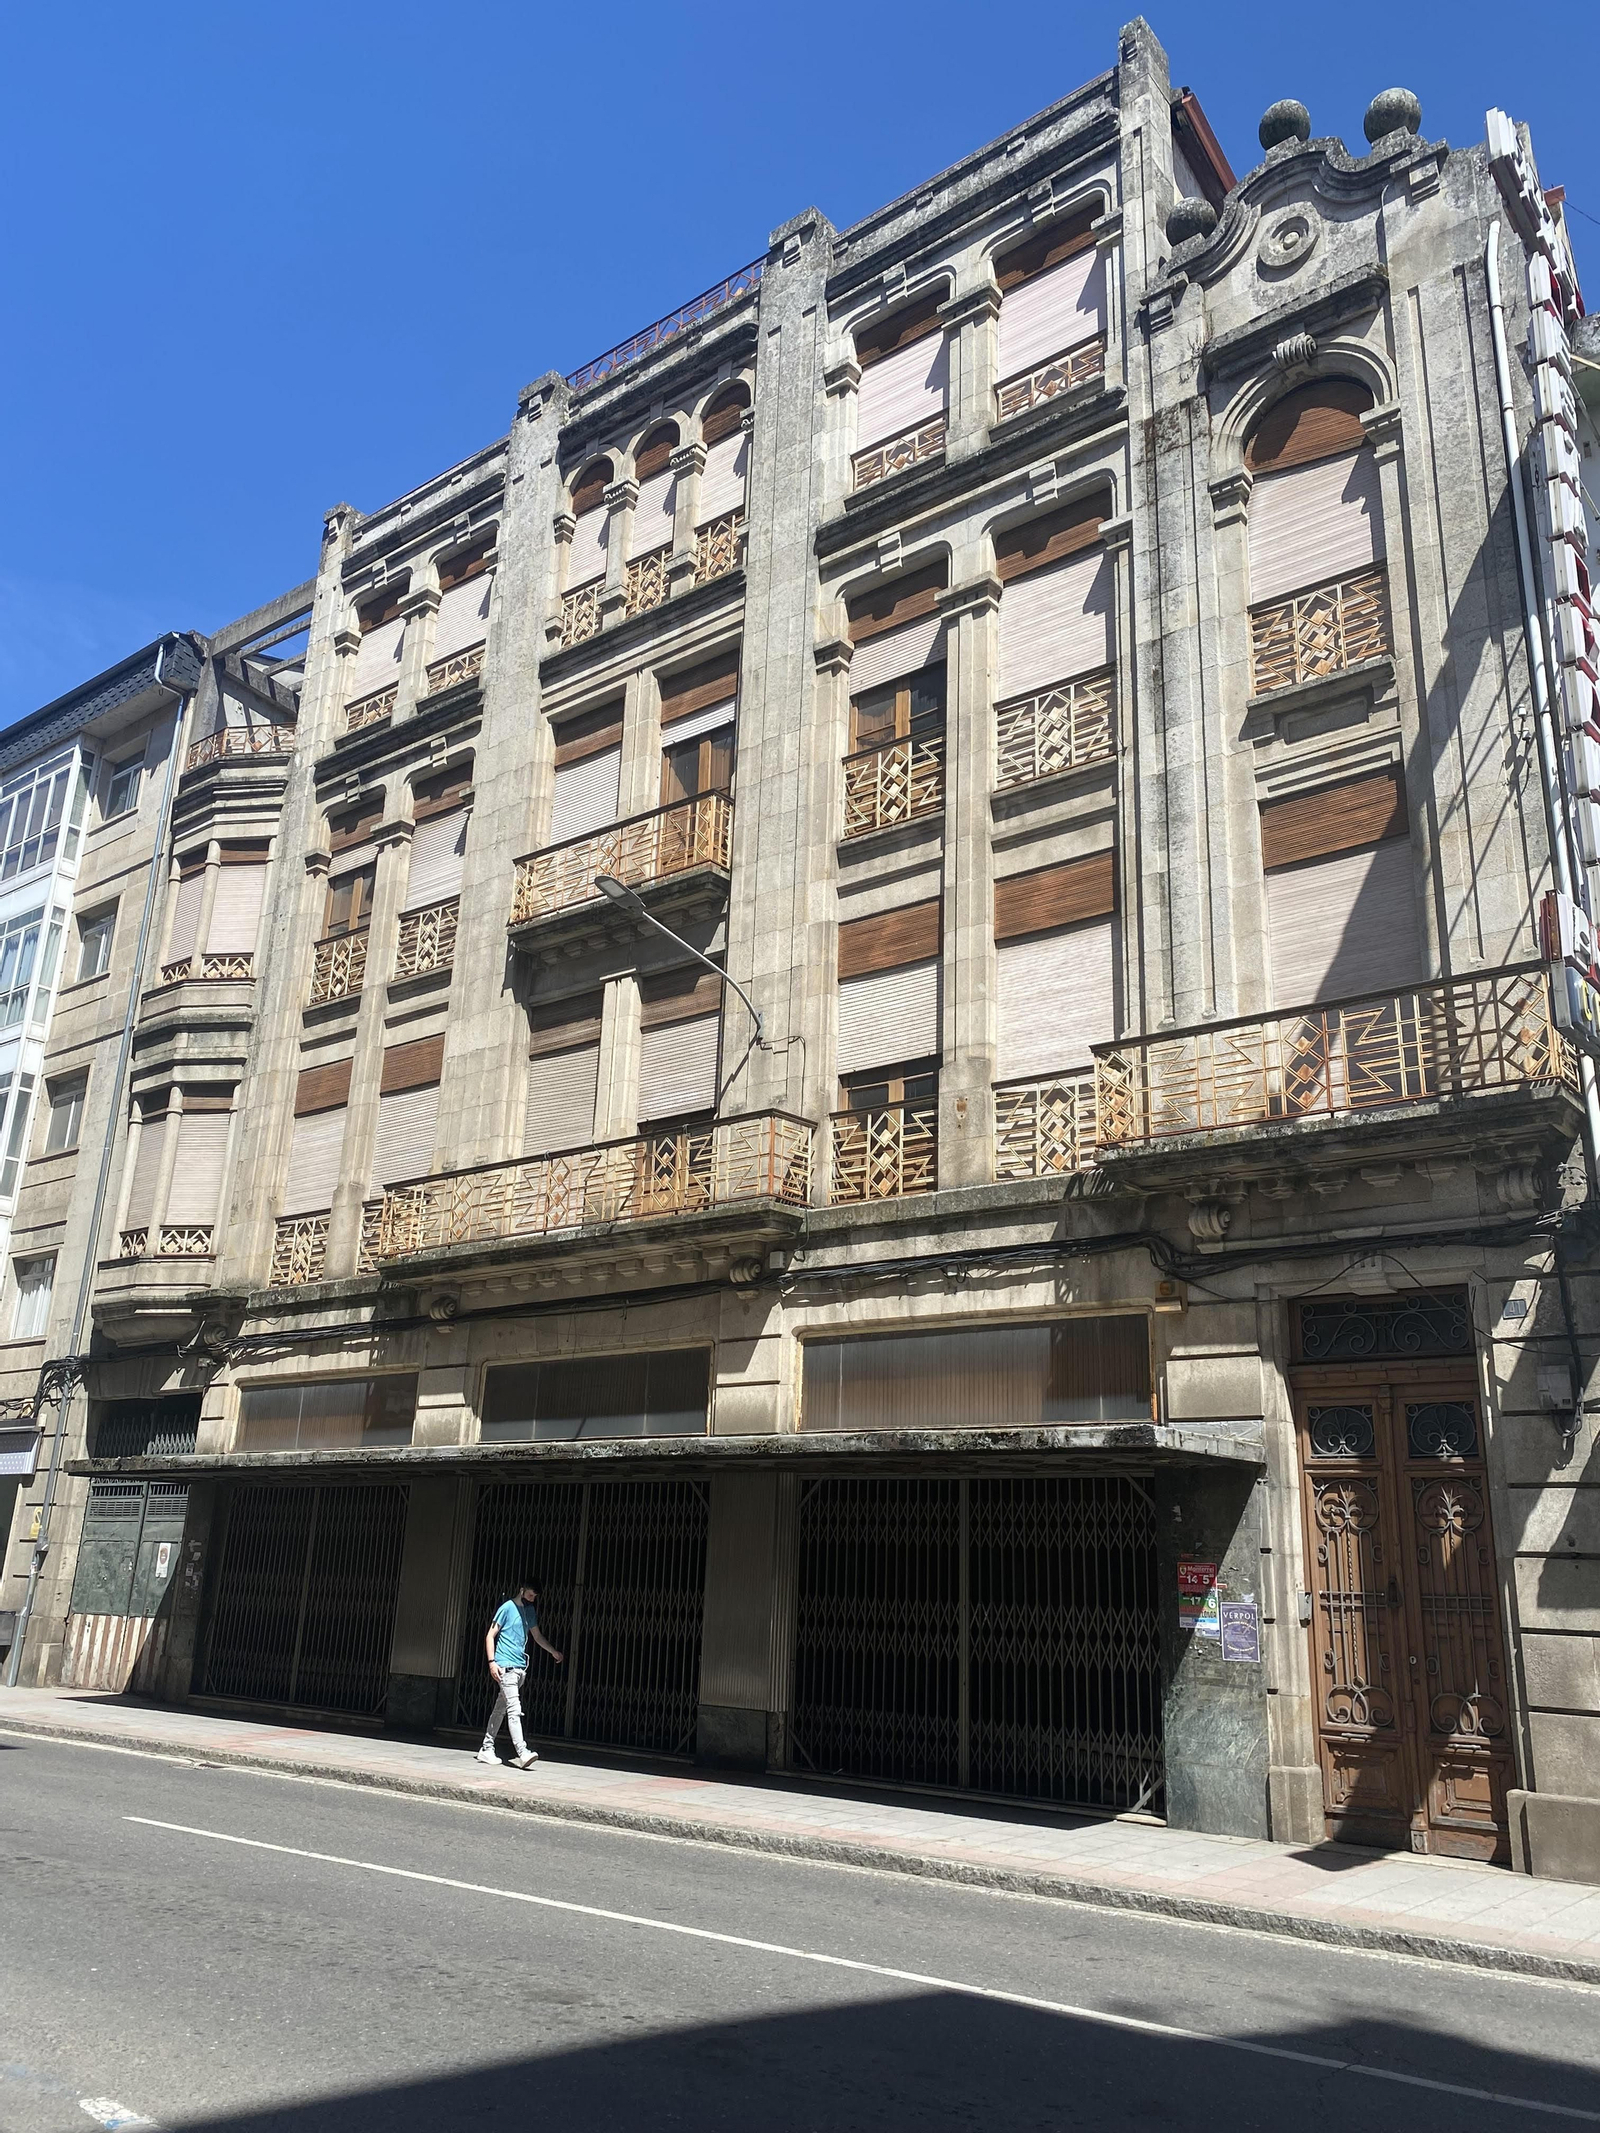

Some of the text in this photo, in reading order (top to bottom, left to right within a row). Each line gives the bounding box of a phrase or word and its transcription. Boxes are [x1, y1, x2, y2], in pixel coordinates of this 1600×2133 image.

[1186, 1574, 1198, 1584] 14
[1202, 1574, 1210, 1585] 5
[1190, 1596, 1201, 1606] 17
[1208, 1598, 1216, 1609] 6
[1223, 1611, 1255, 1620] VERPOL
